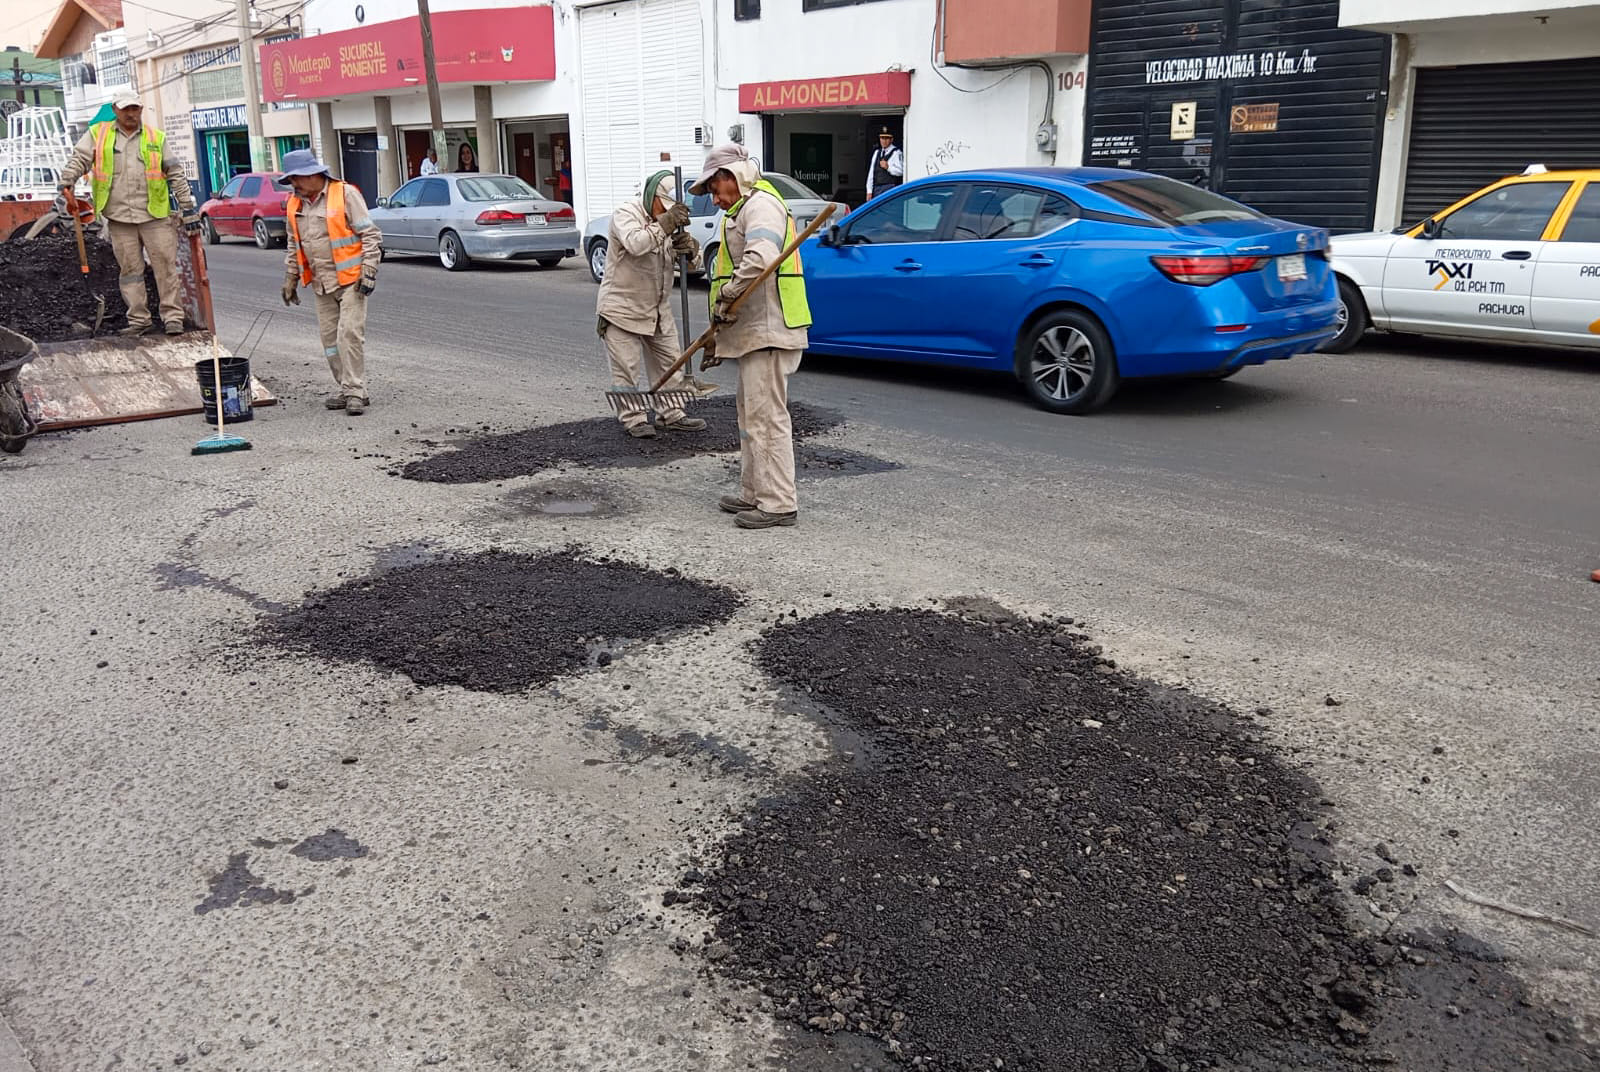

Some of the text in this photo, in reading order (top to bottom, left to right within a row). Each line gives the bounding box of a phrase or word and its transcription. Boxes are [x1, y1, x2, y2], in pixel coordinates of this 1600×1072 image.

[339, 41, 384, 62] SUCURSAL
[340, 58, 387, 79] PONIENTE
[1145, 60, 1203, 84] VELOCIDAD
[1205, 53, 1255, 80] MAXIMA
[1260, 52, 1274, 76] 10
[1058, 71, 1084, 91] 104
[753, 79, 869, 106] ALMONEDA
[1425, 260, 1473, 280] TAXI
[1454, 280, 1505, 293] 01 PCH TM
[1478, 303, 1525, 316] PACHUCA
